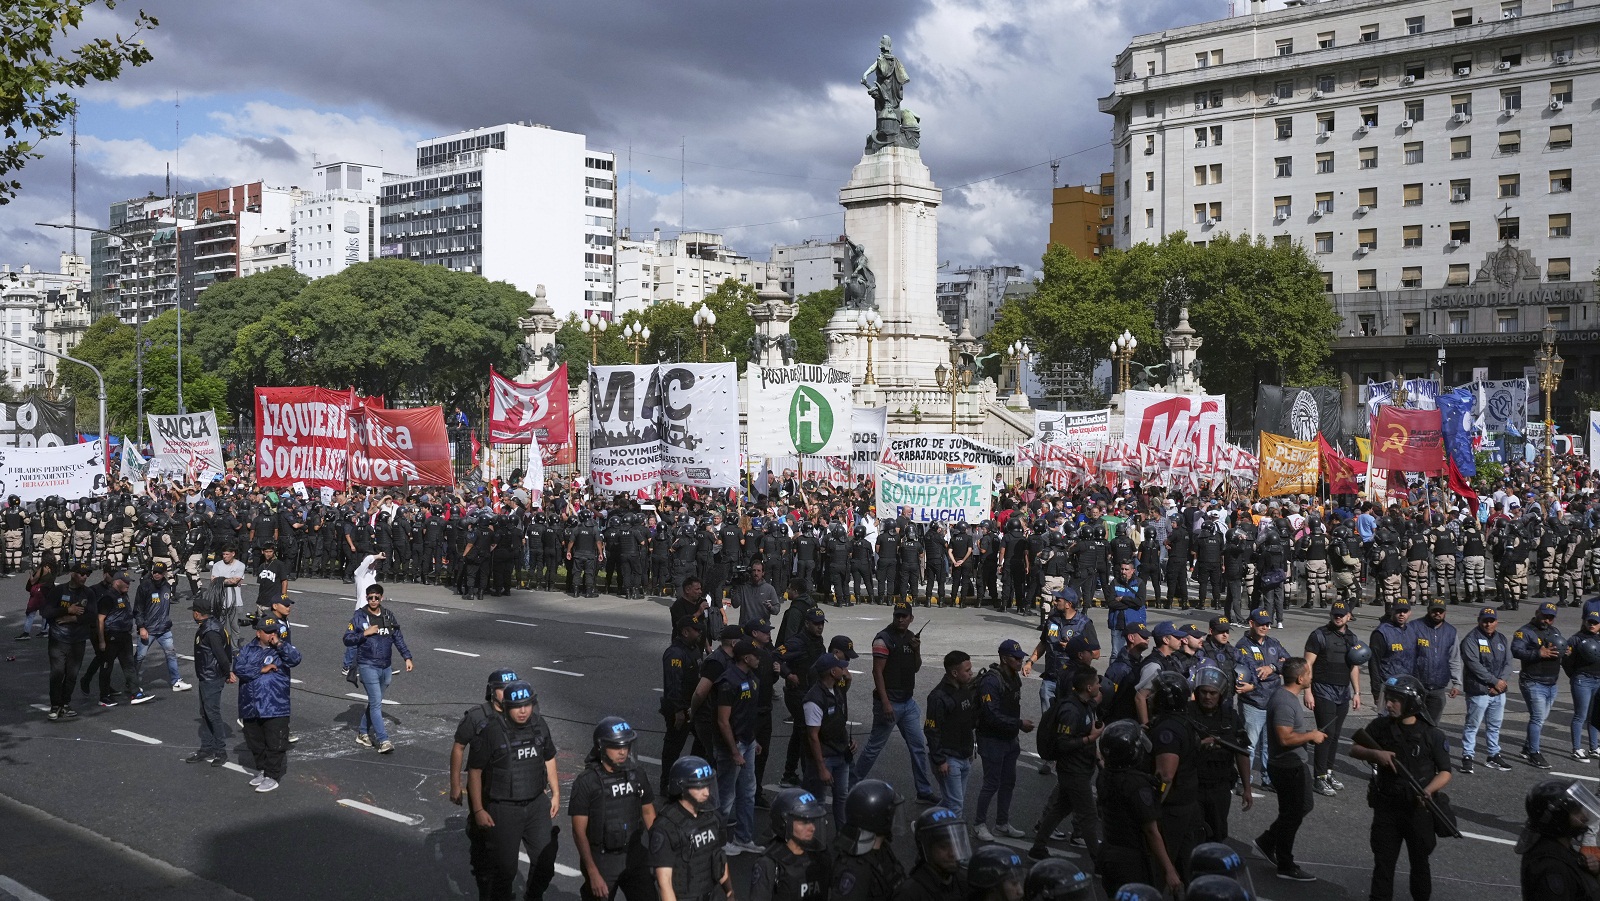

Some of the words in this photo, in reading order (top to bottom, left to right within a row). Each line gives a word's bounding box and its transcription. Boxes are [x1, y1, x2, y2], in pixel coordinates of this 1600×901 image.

[1432, 293, 1486, 308] SENADO
[1489, 292, 1507, 306] DE
[1508, 290, 1526, 305] LA
[1528, 288, 1585, 303] NACION
[1407, 337, 1442, 345] Edificio
[1443, 334, 1491, 345] SENADOR
[1491, 333, 1539, 344] ALFREDO
[760, 367, 790, 390] POSTA
[590, 368, 696, 422] MAC
[1068, 414, 1106, 426] Jubiladxs
[157, 416, 211, 440] ANCLA
[1079, 424, 1106, 434] izquierda
[892, 438, 928, 450] CENTRO
[932, 438, 945, 449] DE
[610, 444, 662, 457] MOVIMIEN
[591, 454, 662, 466] AGRUPACIONES
[894, 450, 961, 462] TRABAJADORES
[964, 452, 1016, 467] PORTUARIOS
[44, 464, 84, 472] PERONISTAS
[352, 450, 420, 482] Obrera
[592, 470, 613, 486] PTS
[898, 472, 972, 485] HOSPITAL
[882, 480, 982, 507] BONAPARTE
[921, 508, 966, 522] LUCHA
[1048, 629, 1058, 638] PFA
[1392, 644, 1404, 652] PFA
[1418, 638, 1430, 647] PFA
[672, 658, 682, 668] PFA
[502, 672, 518, 682] PFA
[511, 689, 530, 701] PFA
[740, 690, 752, 700] PFA
[961, 699, 971, 710] PFA
[612, 722, 630, 734] PFA
[925, 719, 936, 728] PFA
[518, 746, 538, 760] PFA
[612, 782, 634, 798] PFA
[932, 810, 956, 822] PFA
[694, 829, 716, 848] PFA
[800, 882, 821, 898] PFA
